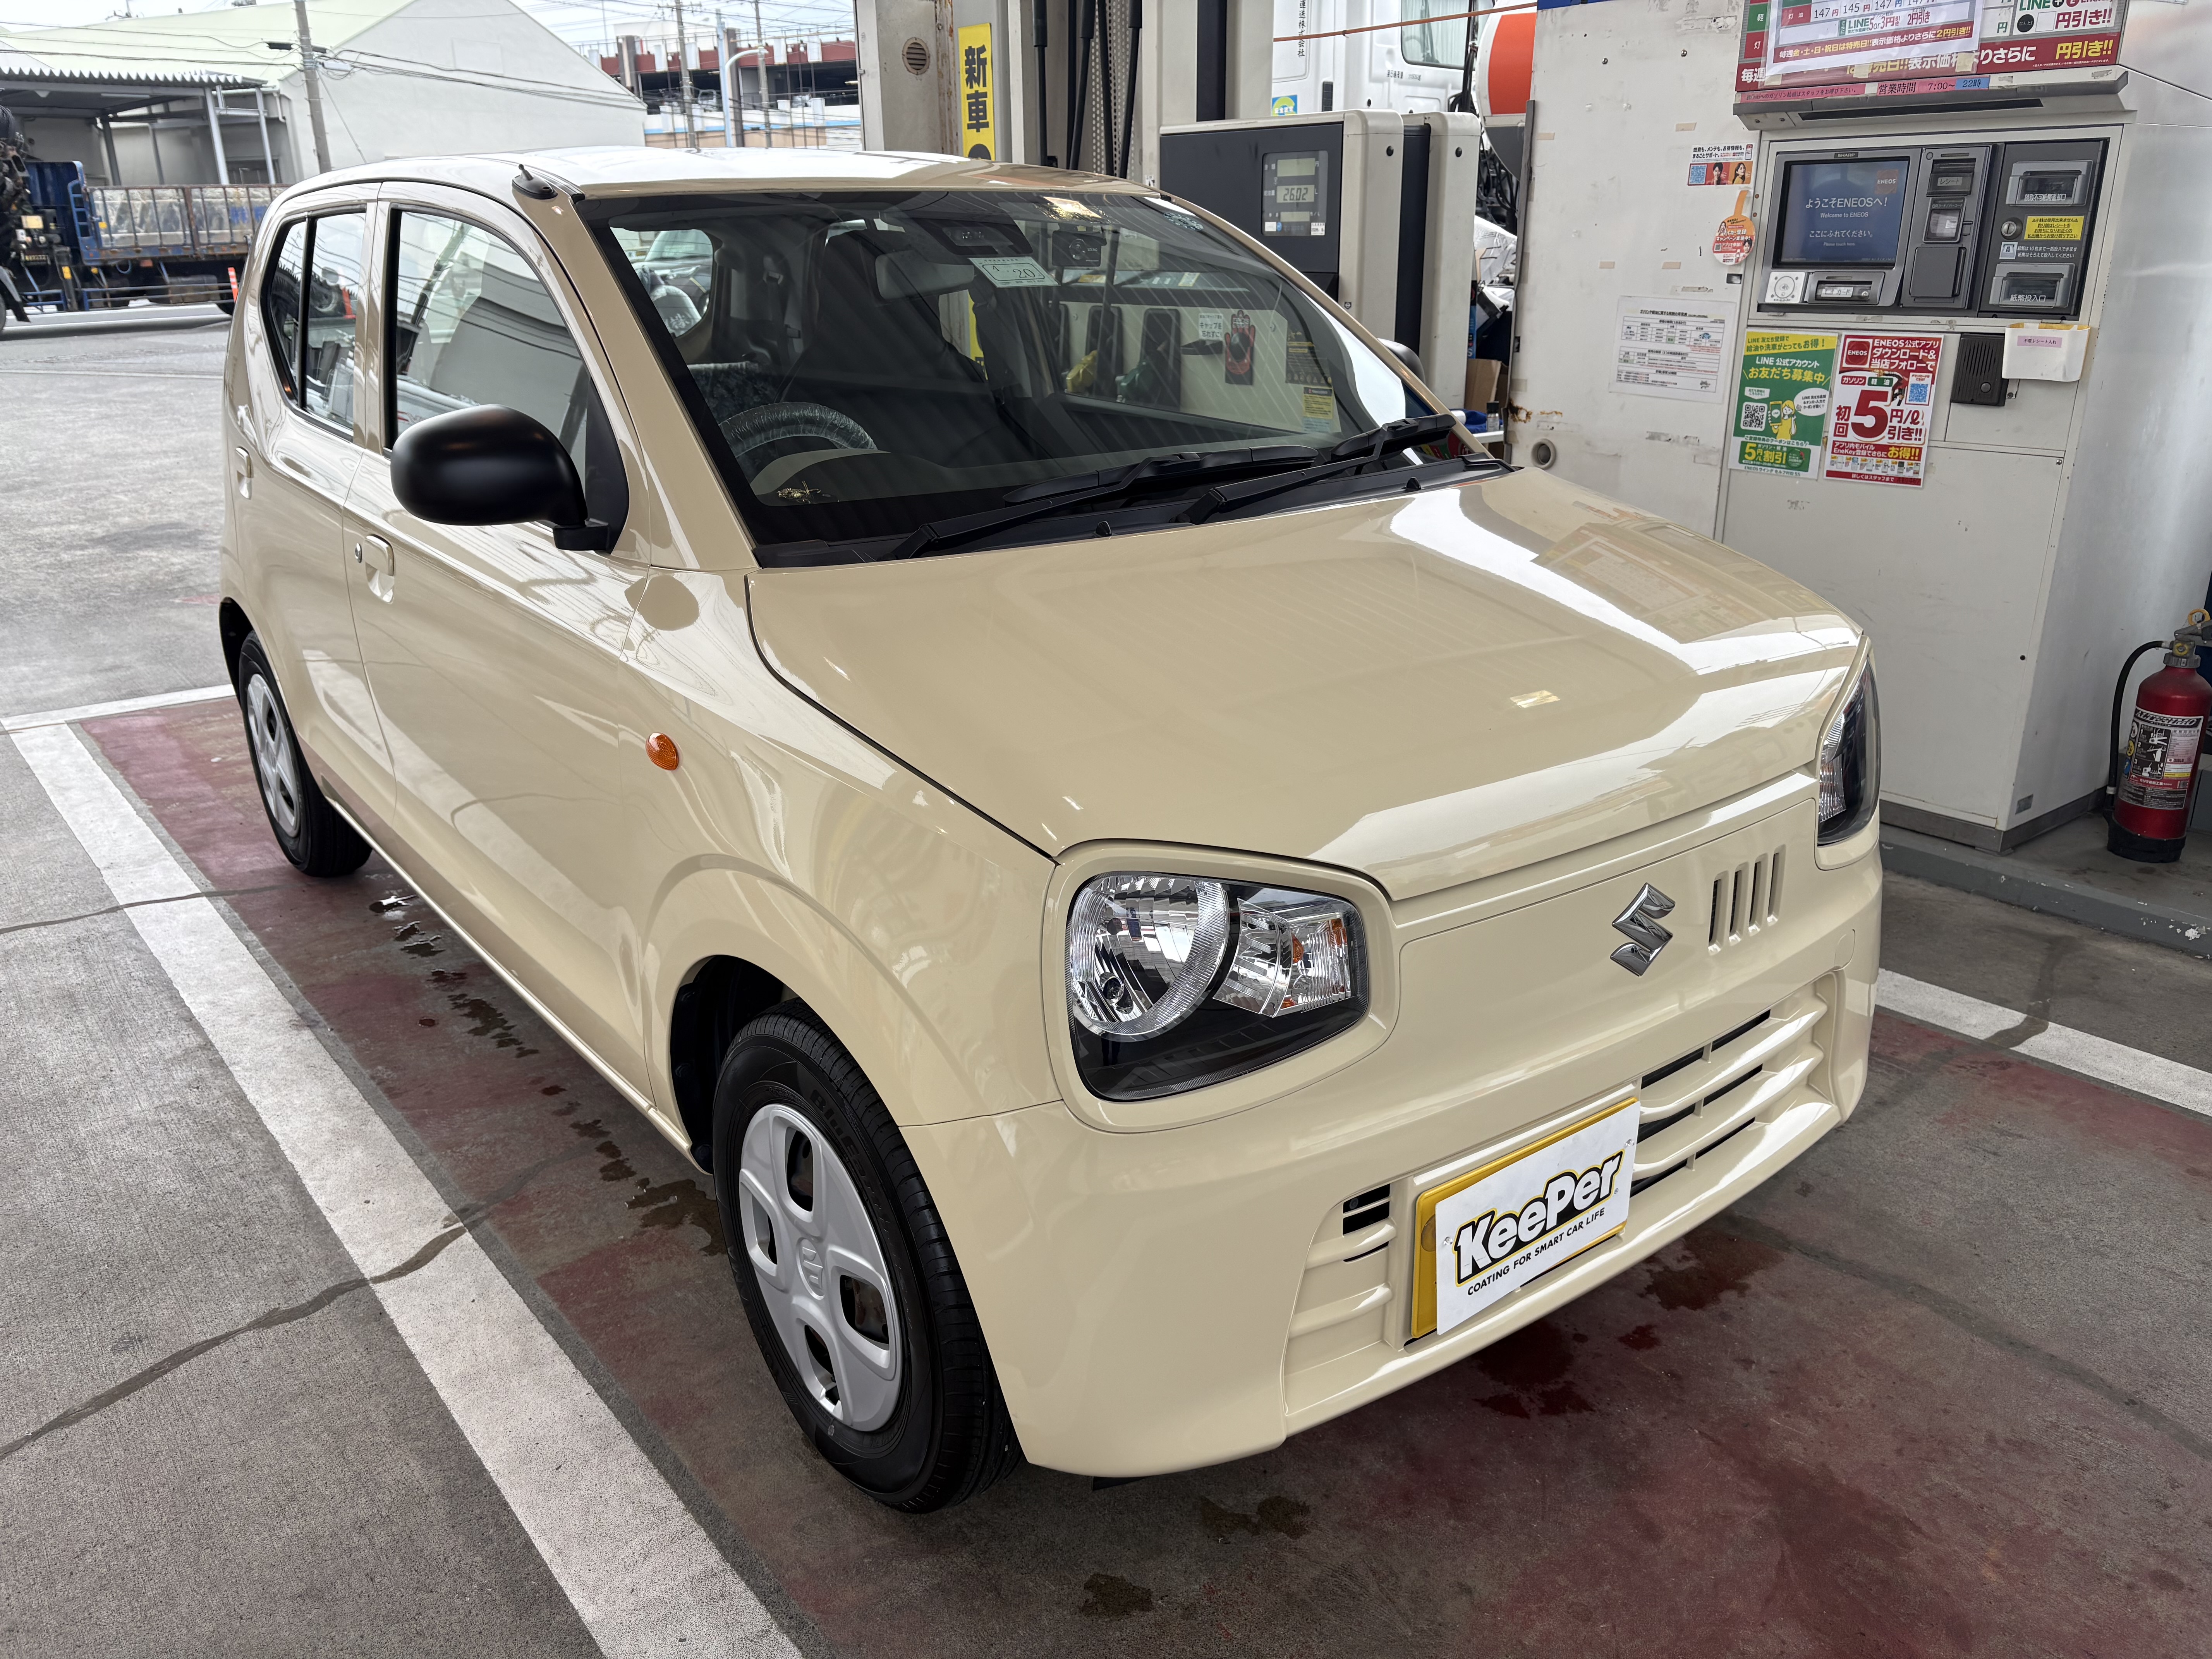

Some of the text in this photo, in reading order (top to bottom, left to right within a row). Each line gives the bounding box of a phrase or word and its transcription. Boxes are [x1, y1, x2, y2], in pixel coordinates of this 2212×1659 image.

[1843, 3, 1870, 14] 145 円
[1875, 0, 1891, 10] 147
[1815, 8, 1830, 18] 147
[1848, 18, 1870, 29] LINE
[1907, 10, 1930, 26] 2円引き
[2055, 8, 2113, 29] 円引き!!
[1997, 21, 2008, 34] 円
[1754, 41, 1761, 49] 灯
[2055, 39, 2114, 60] 円引き!!
[964, 44, 989, 132] 新車
[1879, 82, 1917, 95] 営業時間
[1962, 79, 1981, 88] 22時
[1809, 230, 1874, 238] ここにふれてください。
[1013, 269, 1035, 278] 20
[2010, 294, 2046, 302] 紙幣投入口
[1874, 339, 1939, 348] ENEOS公式アプリ
[1873, 347, 1936, 360] ダウンロード&
[1756, 356, 1820, 368] LINE 公式アカウント
[1870, 358, 1936, 371] 当店フォローで
[1748, 367, 1826, 384] お友だち募集中
[1851, 389, 1889, 438] 5
[1834, 405, 1851, 438] 初回
[1887, 425, 1923, 441] 引き!!
[1834, 442, 1875, 450] アプリ内モバイル
[1744, 443, 1757, 460] 5
[1763, 450, 1787, 464] 割引
[1887, 446, 1920, 460] お得!!
[1851, 473, 1895, 482] 詳しくはスタッフまで
[2135, 711, 2197, 726] ALTESIMO
[1454, 1151, 1624, 1285] KeePer
[1467, 1207, 1605, 1296] COATING FOR SMART CAR LIFE
